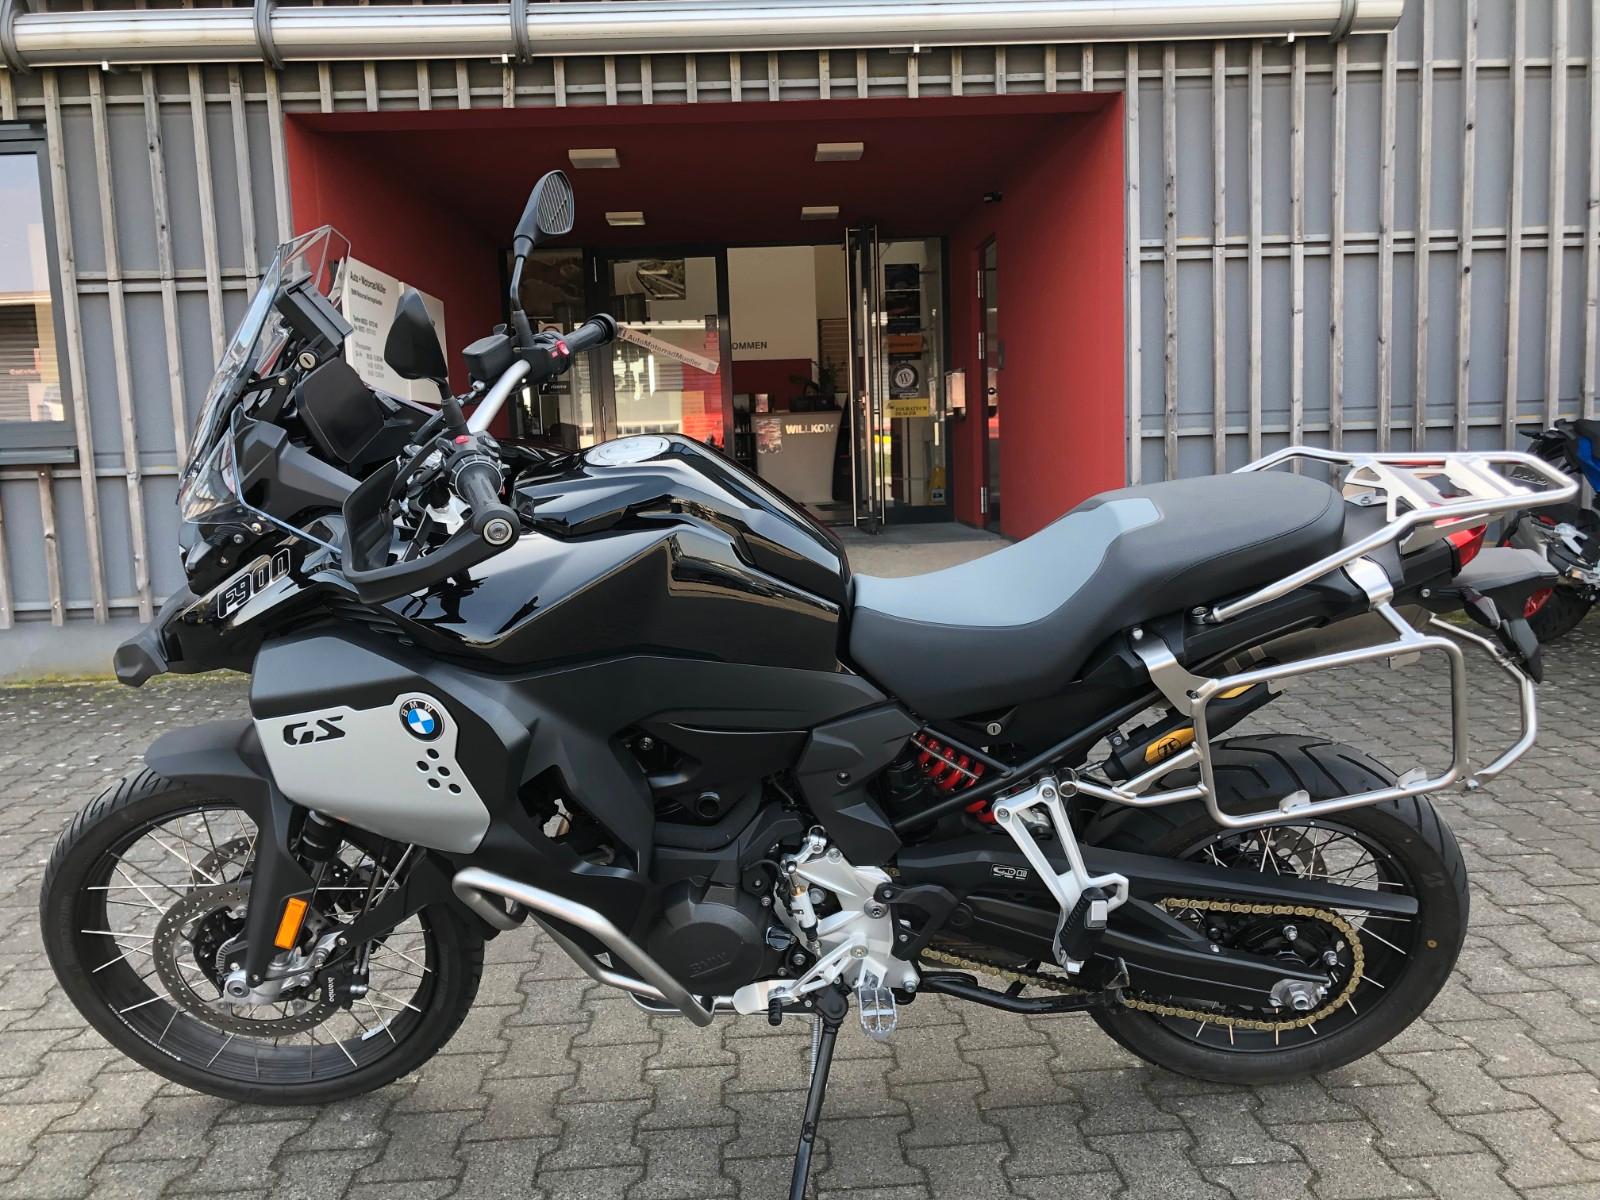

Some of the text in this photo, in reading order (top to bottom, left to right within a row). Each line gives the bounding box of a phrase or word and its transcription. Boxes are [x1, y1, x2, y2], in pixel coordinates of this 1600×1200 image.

[731, 341, 767, 350] OMMEN
[217, 548, 291, 619] F900
[282, 715, 346, 746] GS
[327, 976, 337, 1003] brembo
